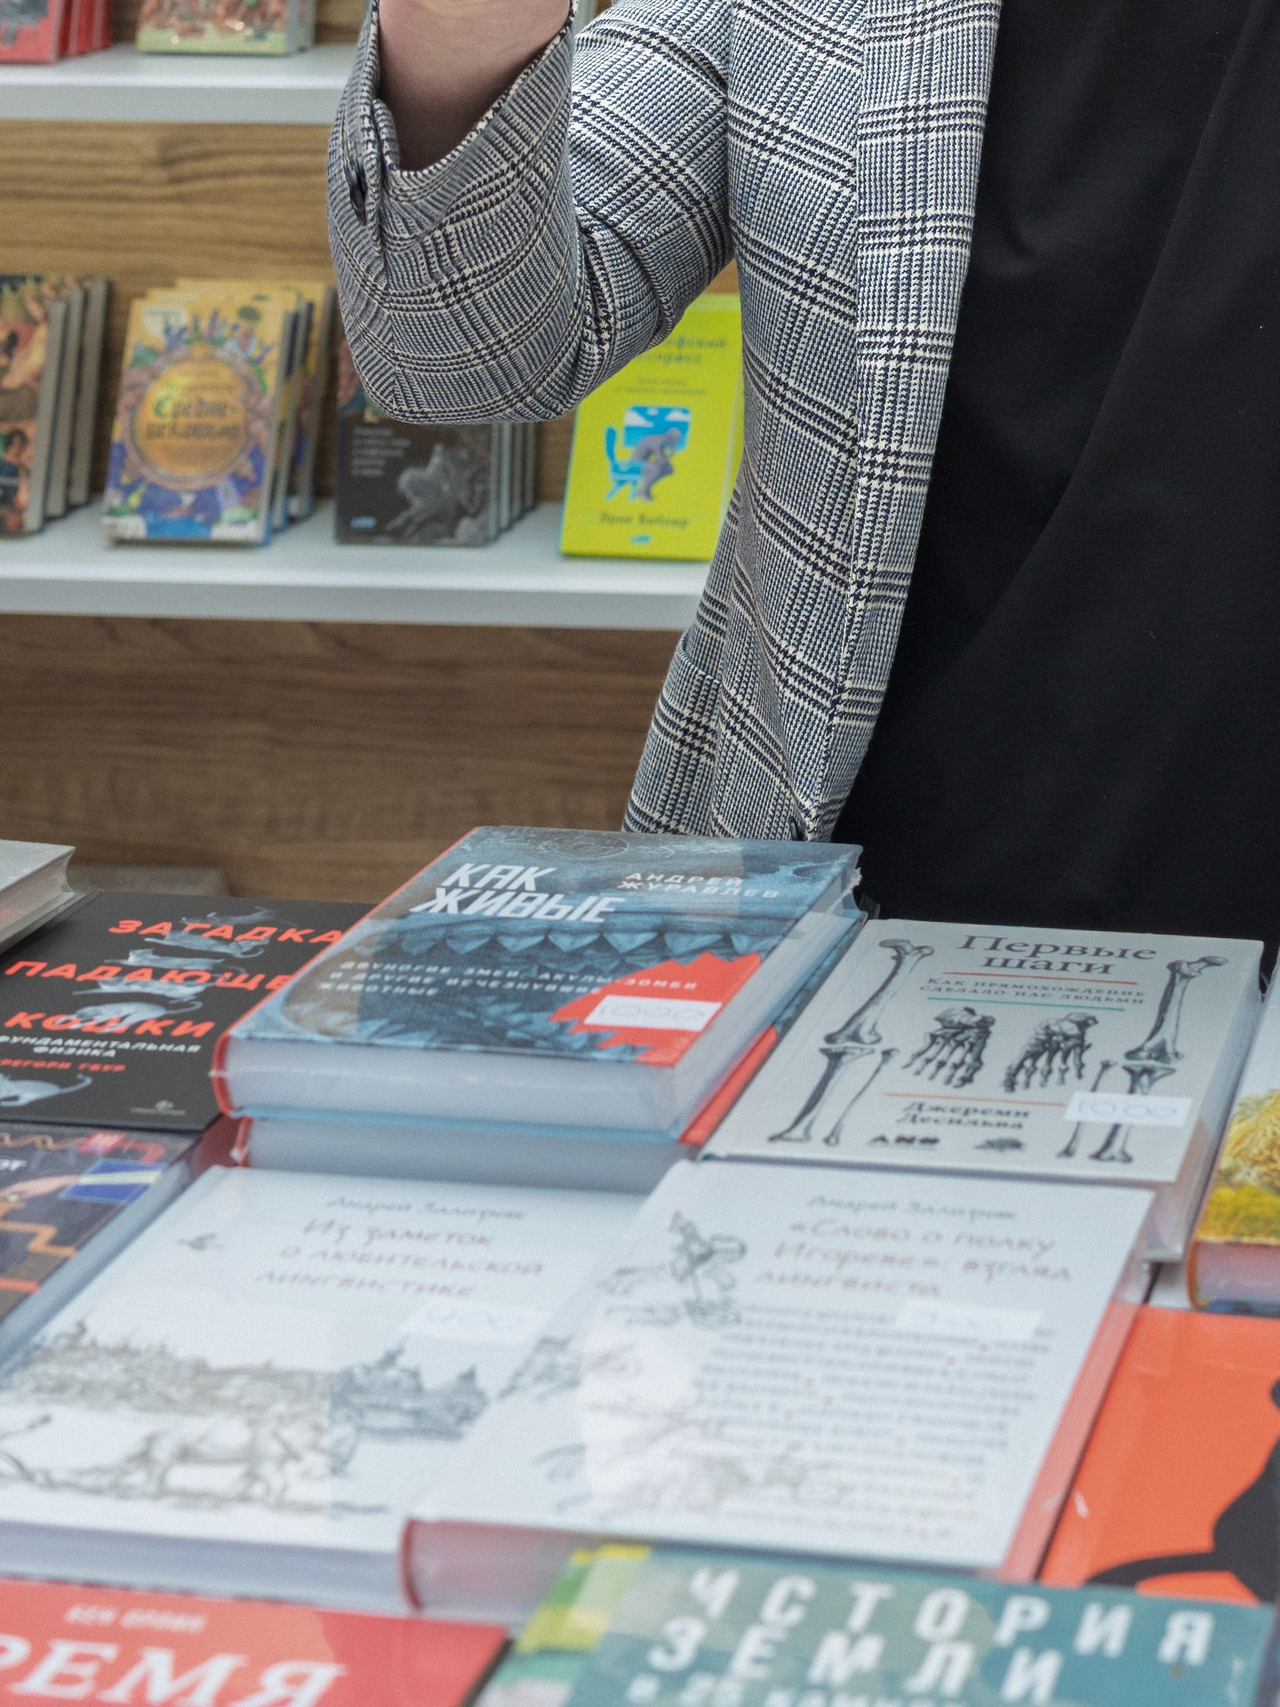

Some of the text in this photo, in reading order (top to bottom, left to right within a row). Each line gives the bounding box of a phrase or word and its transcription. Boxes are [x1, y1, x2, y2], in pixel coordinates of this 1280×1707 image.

[440, 864, 557, 892] КАК
[625, 872, 744, 886] АНДРЕЙ
[410, 886, 625, 924] ЖИВЫЕ
[109, 920, 346, 944] ЗАГАДКА
[957, 935, 1157, 962] Первые
[339, 961, 452, 975] ДВУНОГИЕ
[979, 955, 1115, 977] шаги
[317, 981, 439, 997] ЖИВОТНЫЕ
[352, 972, 435, 985] ДРУГИЕ
[446, 976, 602, 995] ИСЧЕЗНУВШИЕ
[973, 981, 1145, 997] ПРЯМОХОЖДЕНИЕ
[919, 985, 1145, 1005] СДЕЛАЛО НАС ЛЮДЬМИ
[3, 1011, 216, 1038] КОШКИ
[33, 1046, 117, 1058] ФИЗИКА
[901, 1101, 1030, 1119] Джереми
[895, 1112, 1024, 1130] Десильва
[648, 1616, 1065, 1705] ЗЕМЛИ
